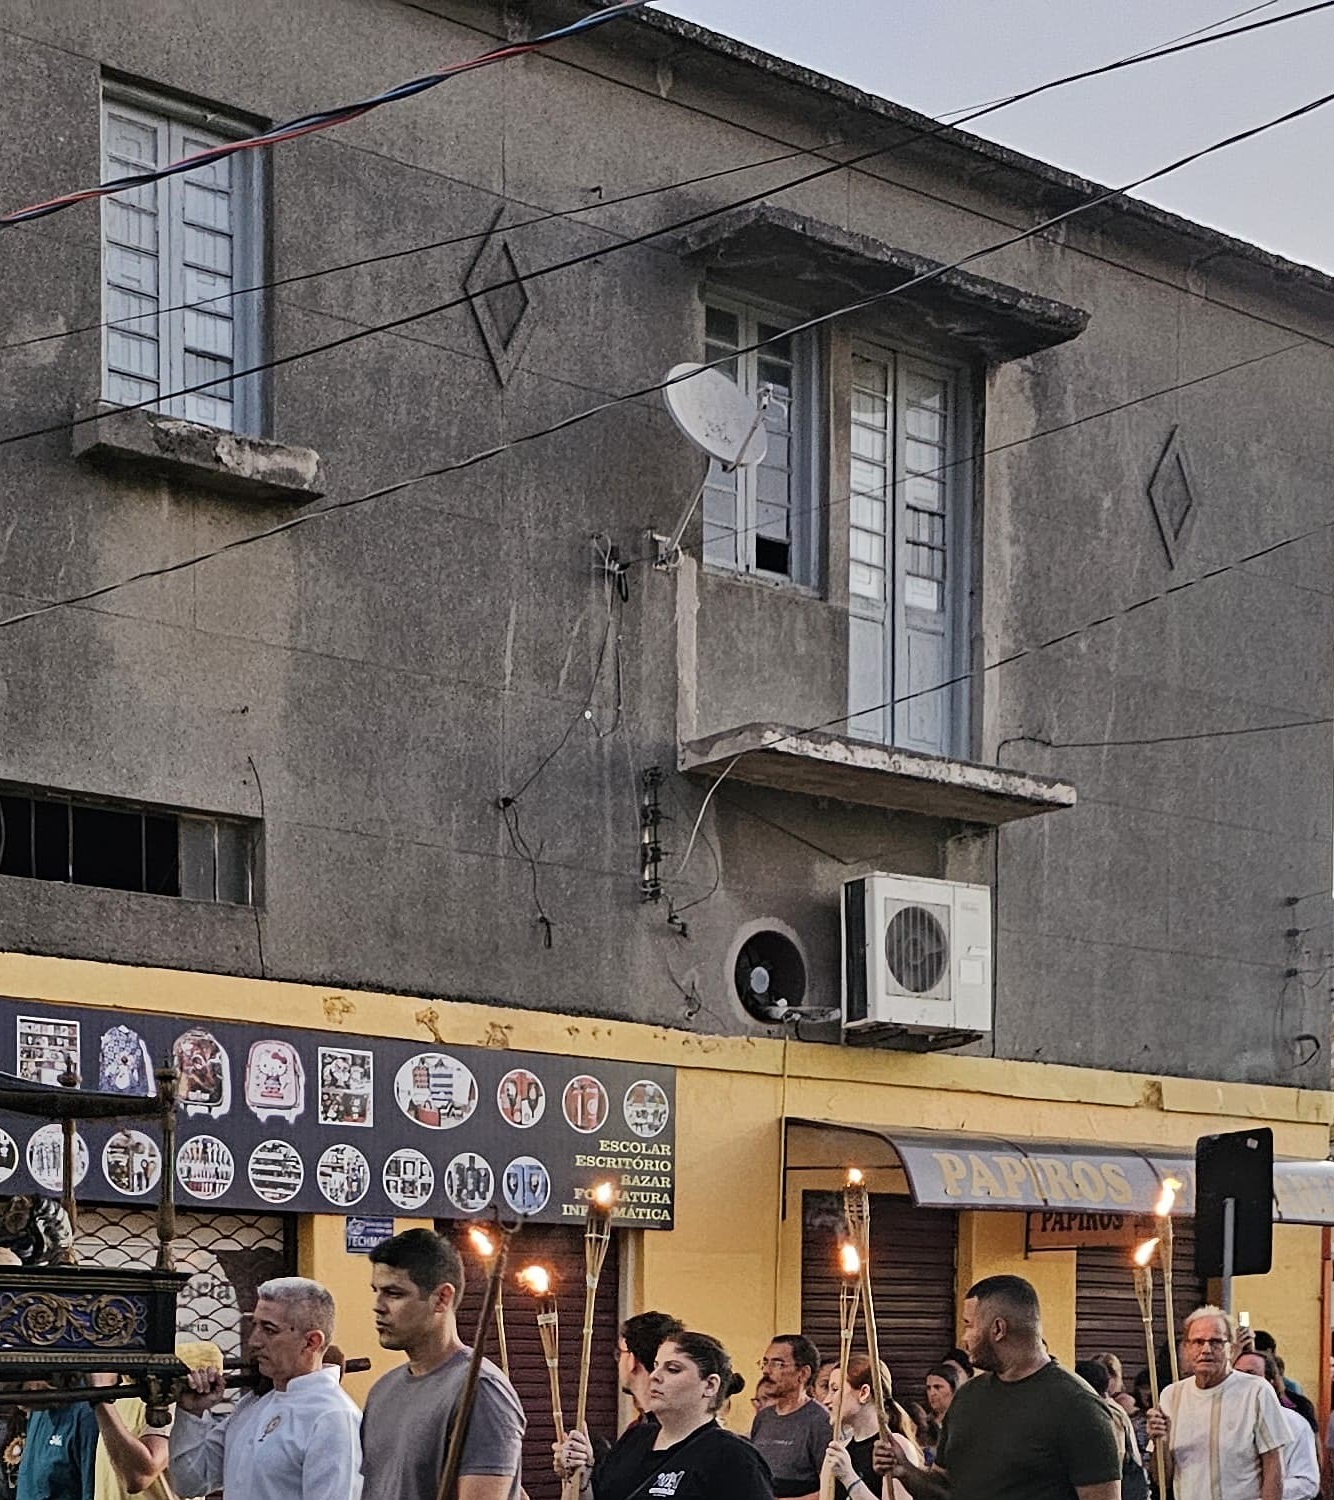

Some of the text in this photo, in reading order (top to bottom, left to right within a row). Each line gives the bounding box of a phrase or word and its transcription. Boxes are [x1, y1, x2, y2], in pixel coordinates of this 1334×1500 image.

[599, 1140, 672, 1156] ESCOLAR
[575, 1154, 672, 1172] ESCRITÓRIO
[620, 1174, 672, 1188] BAZAR
[932, 1152, 1132, 1204] PAPIROS
